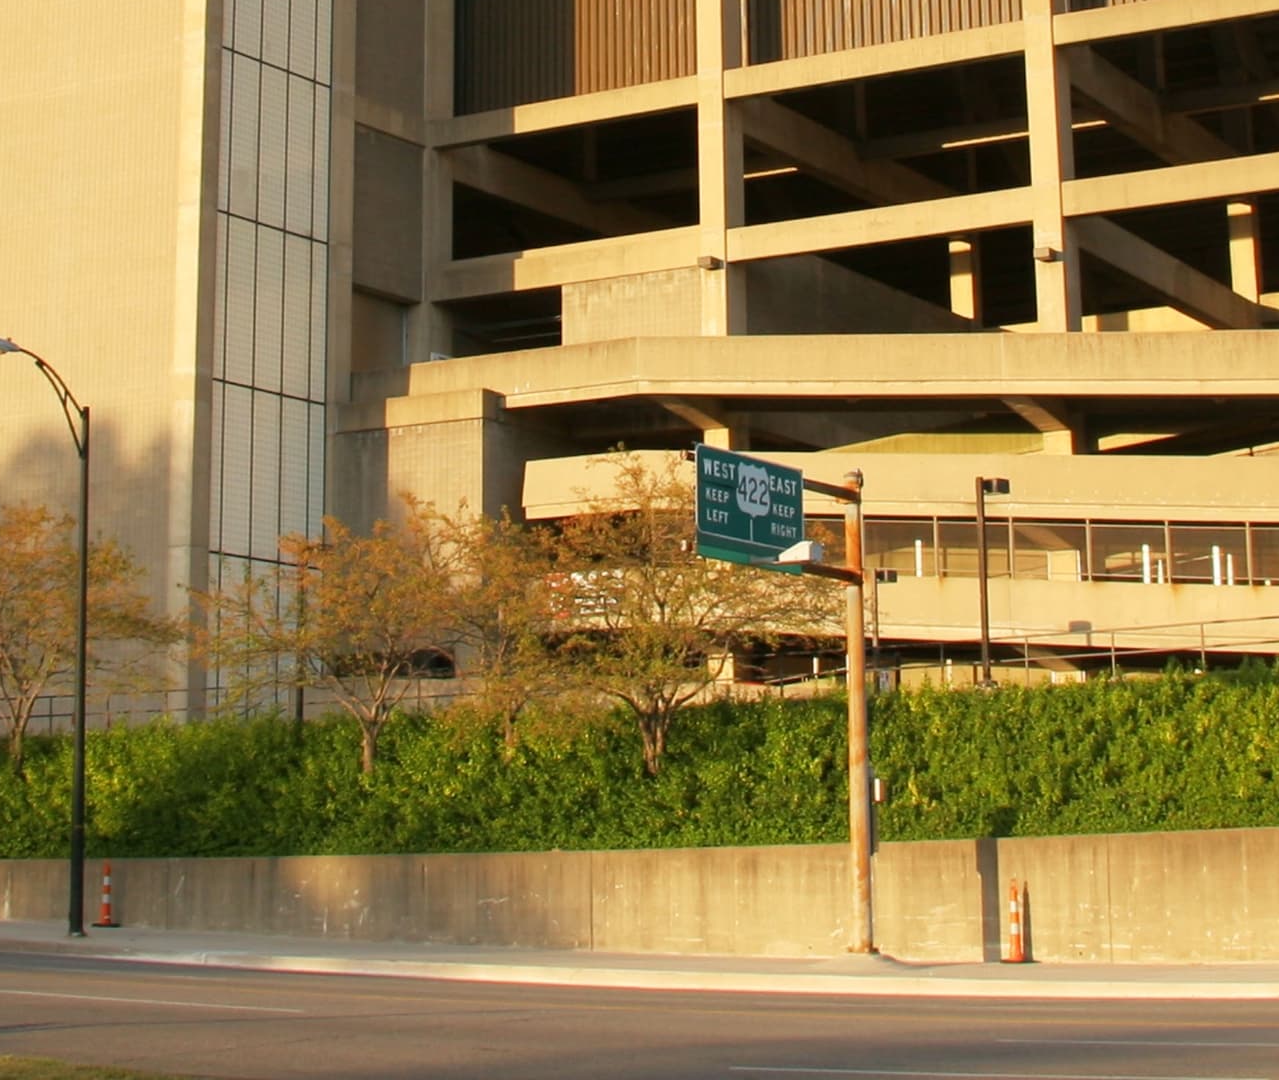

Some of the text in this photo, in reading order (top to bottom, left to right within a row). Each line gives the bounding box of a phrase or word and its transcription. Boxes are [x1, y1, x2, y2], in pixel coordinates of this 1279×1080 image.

[703, 458, 736, 480] WEST
[738, 475, 769, 506] 422
[769, 475, 797, 496] EAST
[705, 487, 729, 503] KEEP
[706, 508, 728, 524] LEFT
[773, 503, 795, 518] KEEP
[771, 522, 797, 538] RIGHT
